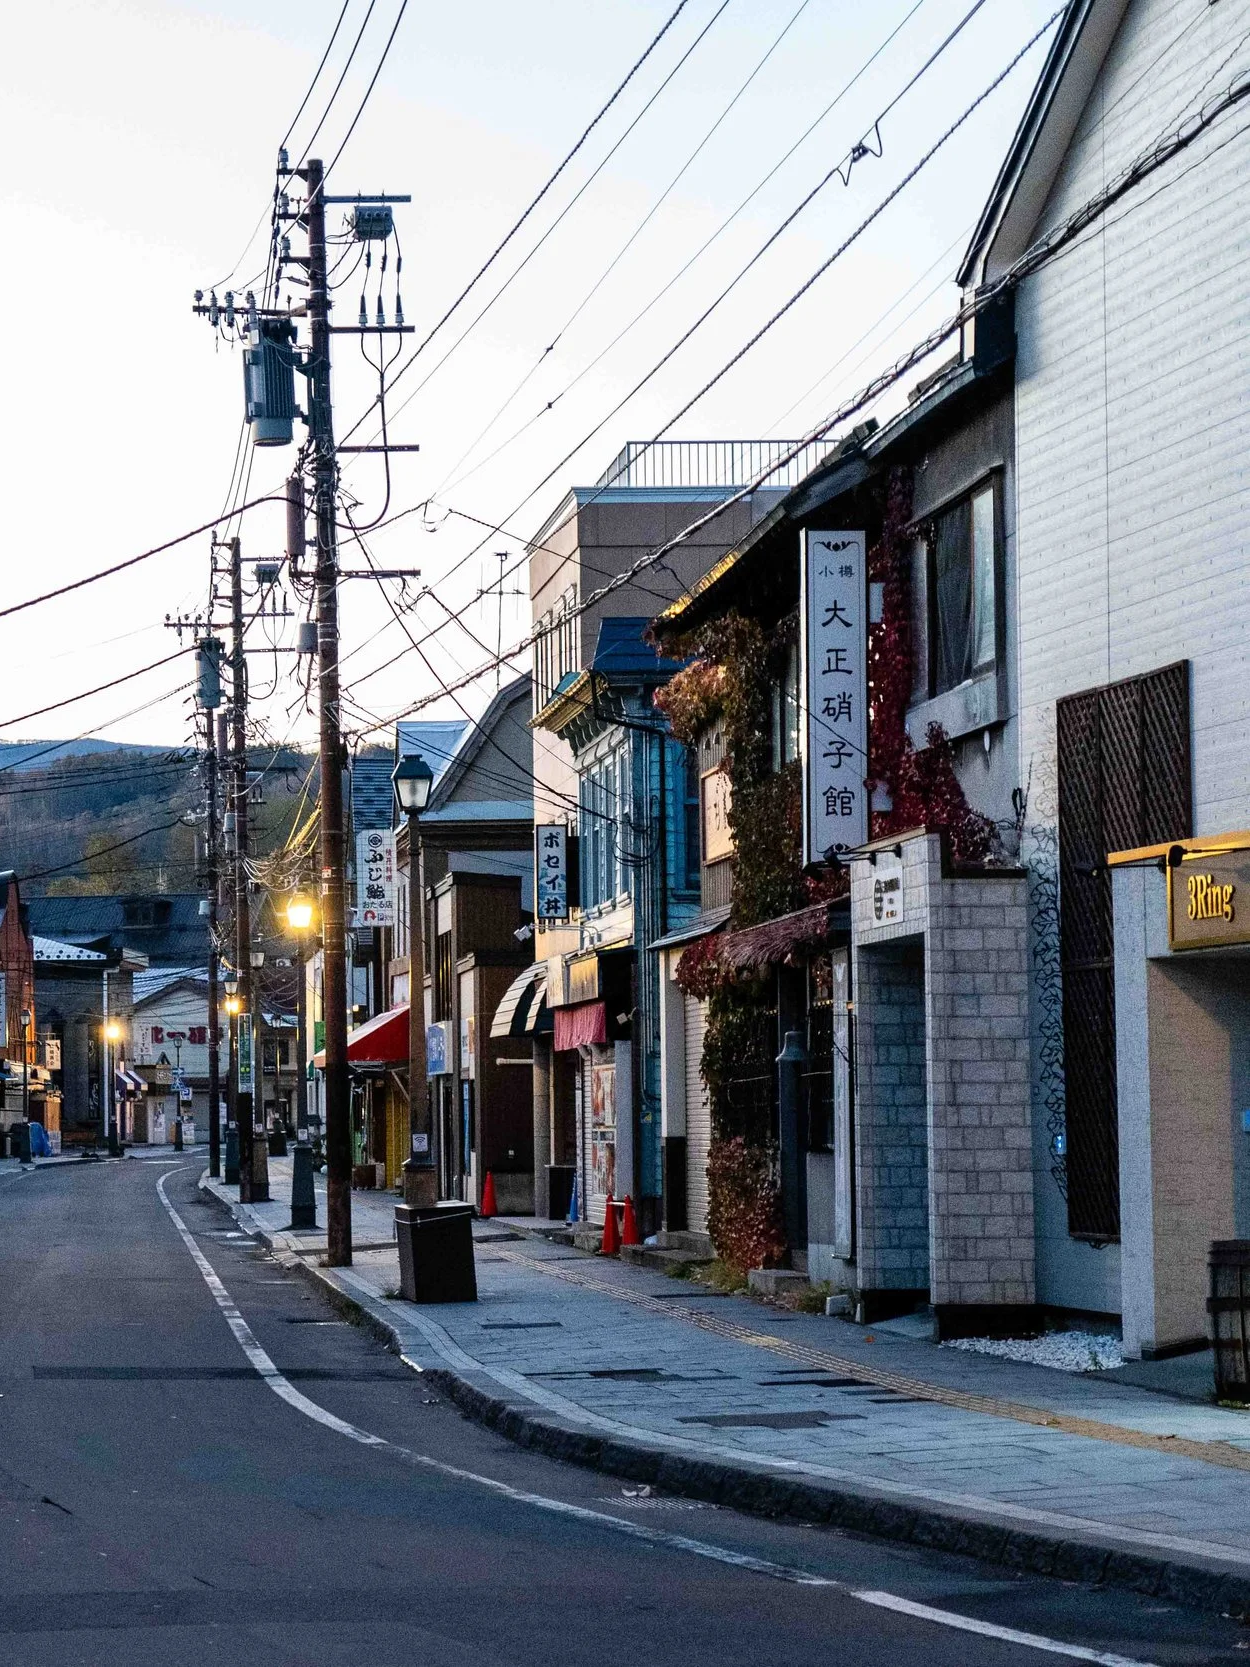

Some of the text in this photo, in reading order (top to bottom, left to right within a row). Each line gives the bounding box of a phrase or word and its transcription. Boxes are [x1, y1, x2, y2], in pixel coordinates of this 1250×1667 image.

[818, 565, 854, 578] 小樽
[821, 599, 856, 817] 大正硝子館
[543, 831, 561, 914] ポセイ丼
[1187, 874, 1233, 921] 3Ring
